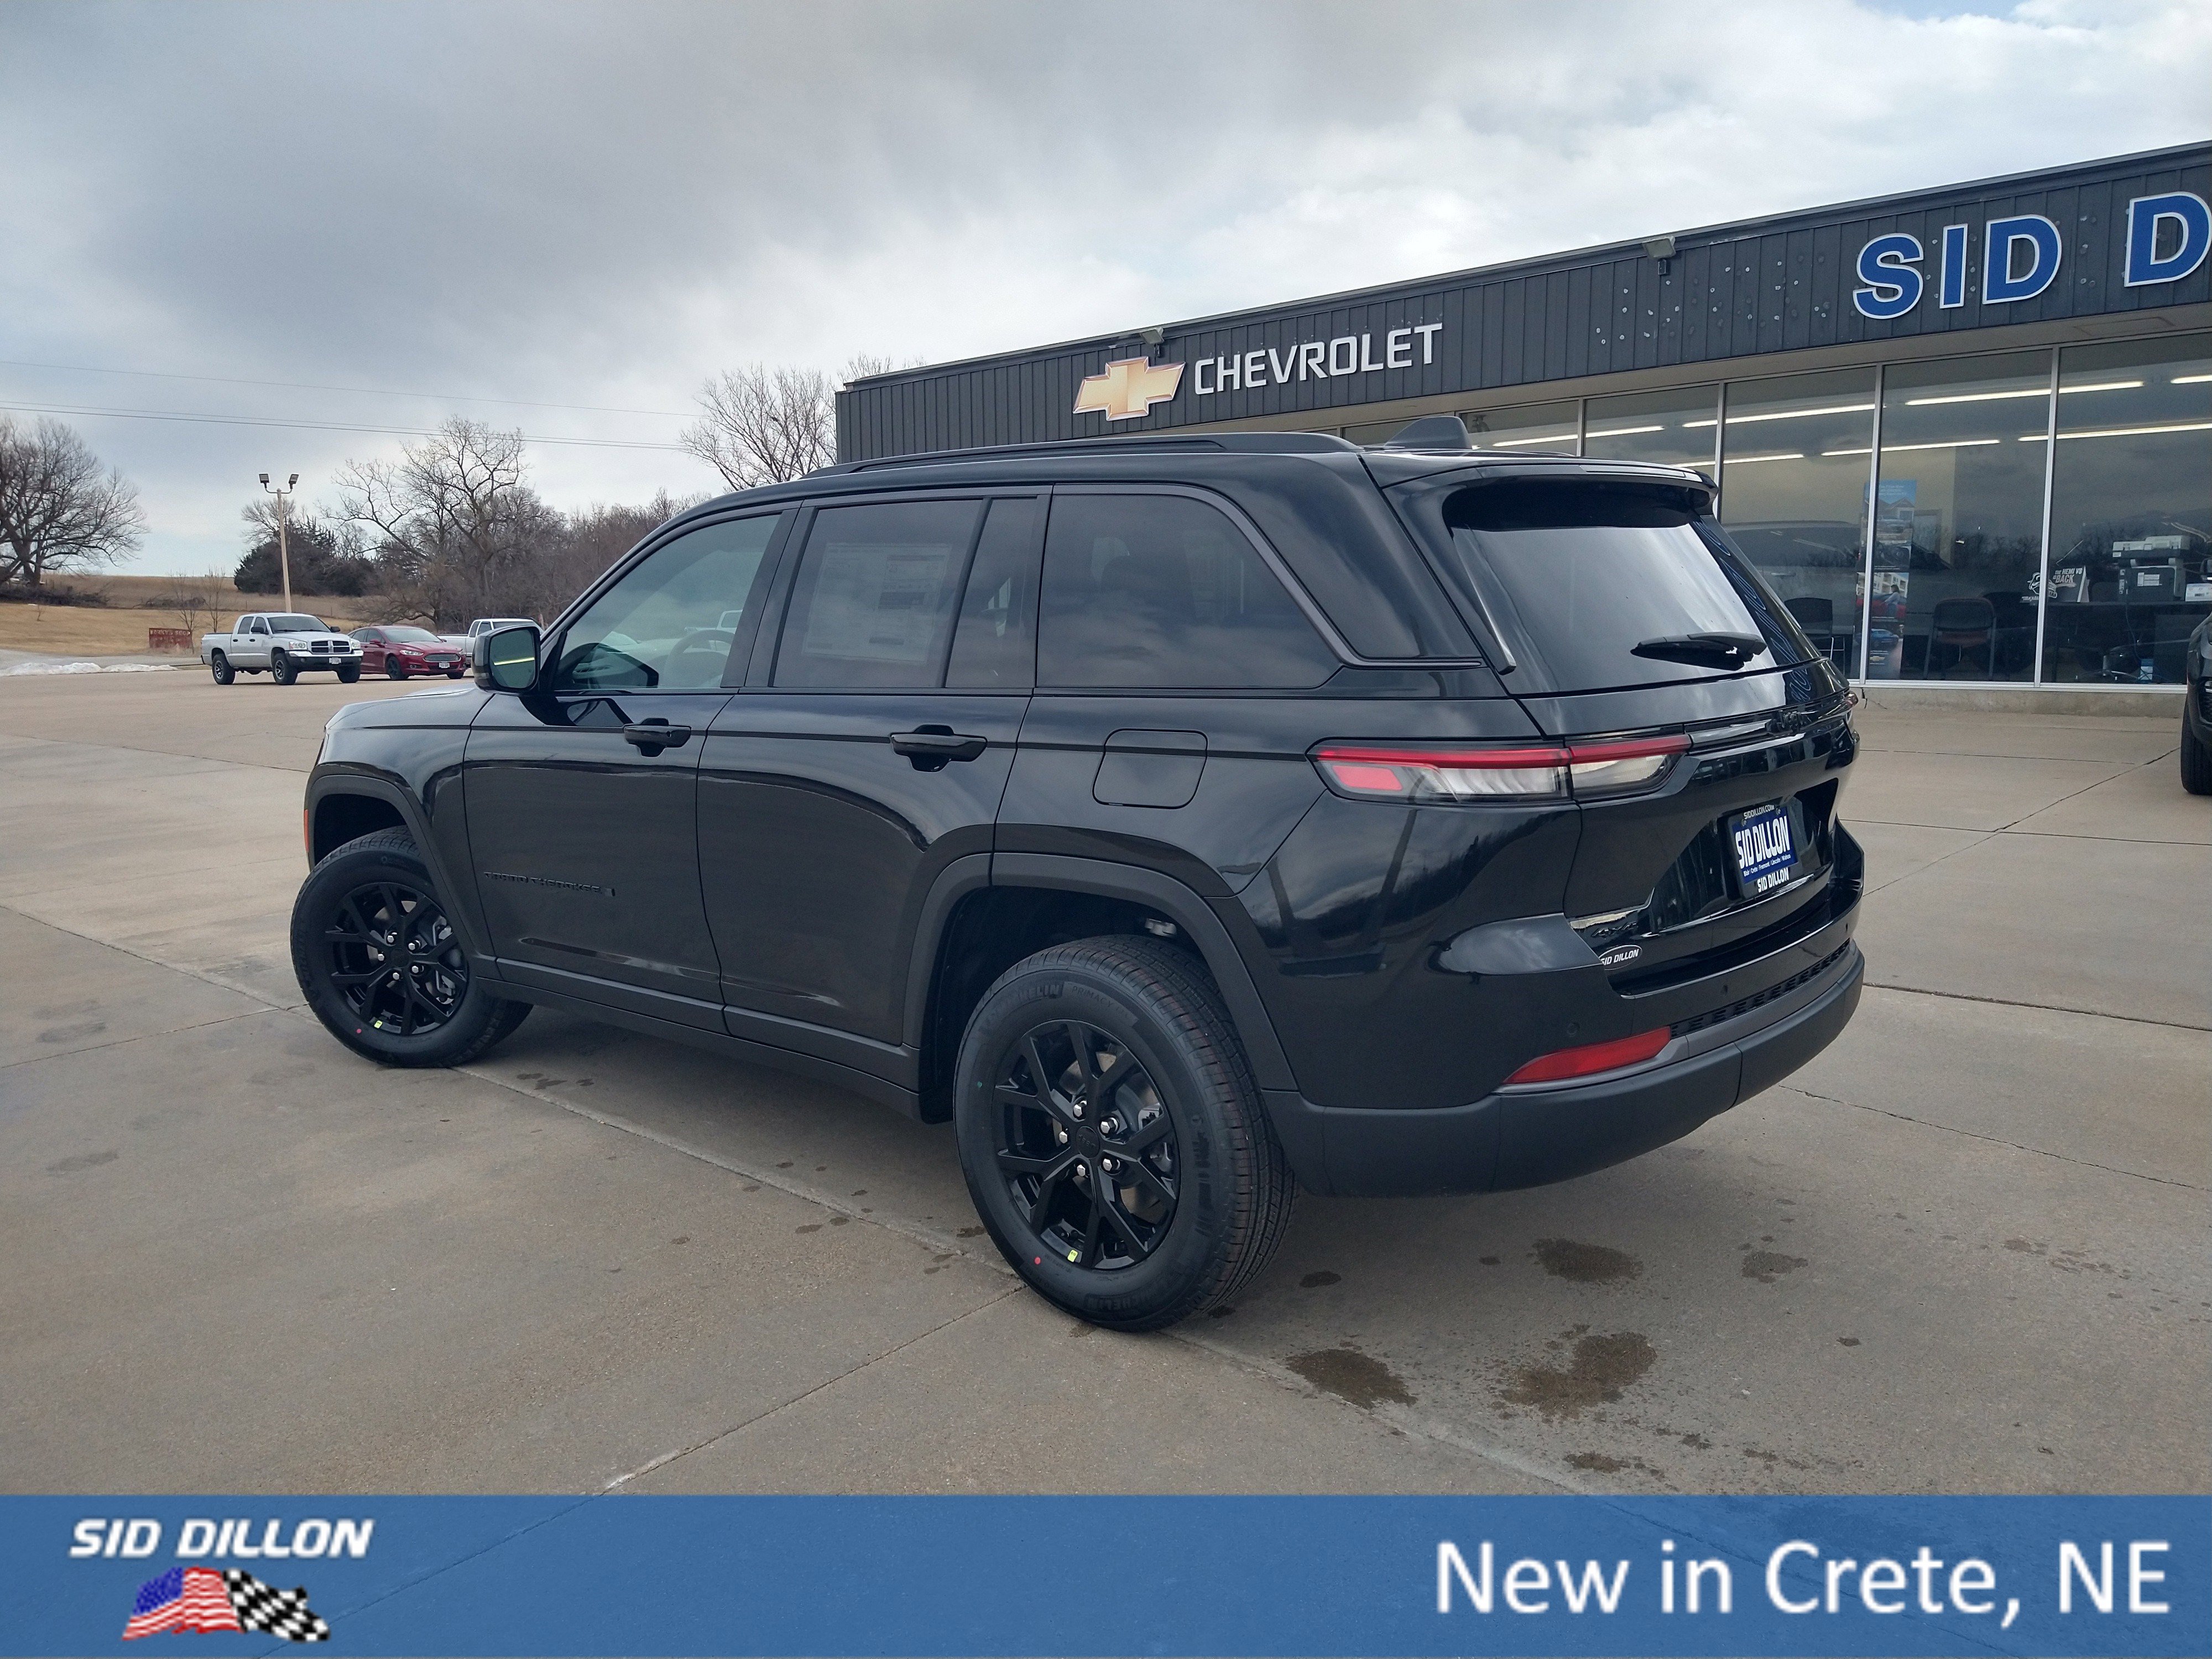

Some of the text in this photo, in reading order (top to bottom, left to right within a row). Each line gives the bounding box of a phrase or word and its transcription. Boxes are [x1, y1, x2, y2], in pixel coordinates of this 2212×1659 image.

[1852, 191, 2212, 320] SID D
[1194, 322, 1443, 395] CHEVROLET
[2056, 574, 2075, 583] BACK
[1743, 805, 1775, 820] SIDDILLON.COM
[1735, 815, 1791, 869] SID DILLON
[1757, 867, 1790, 893] SID DILLON
[1613, 948, 1639, 963] DILLON
